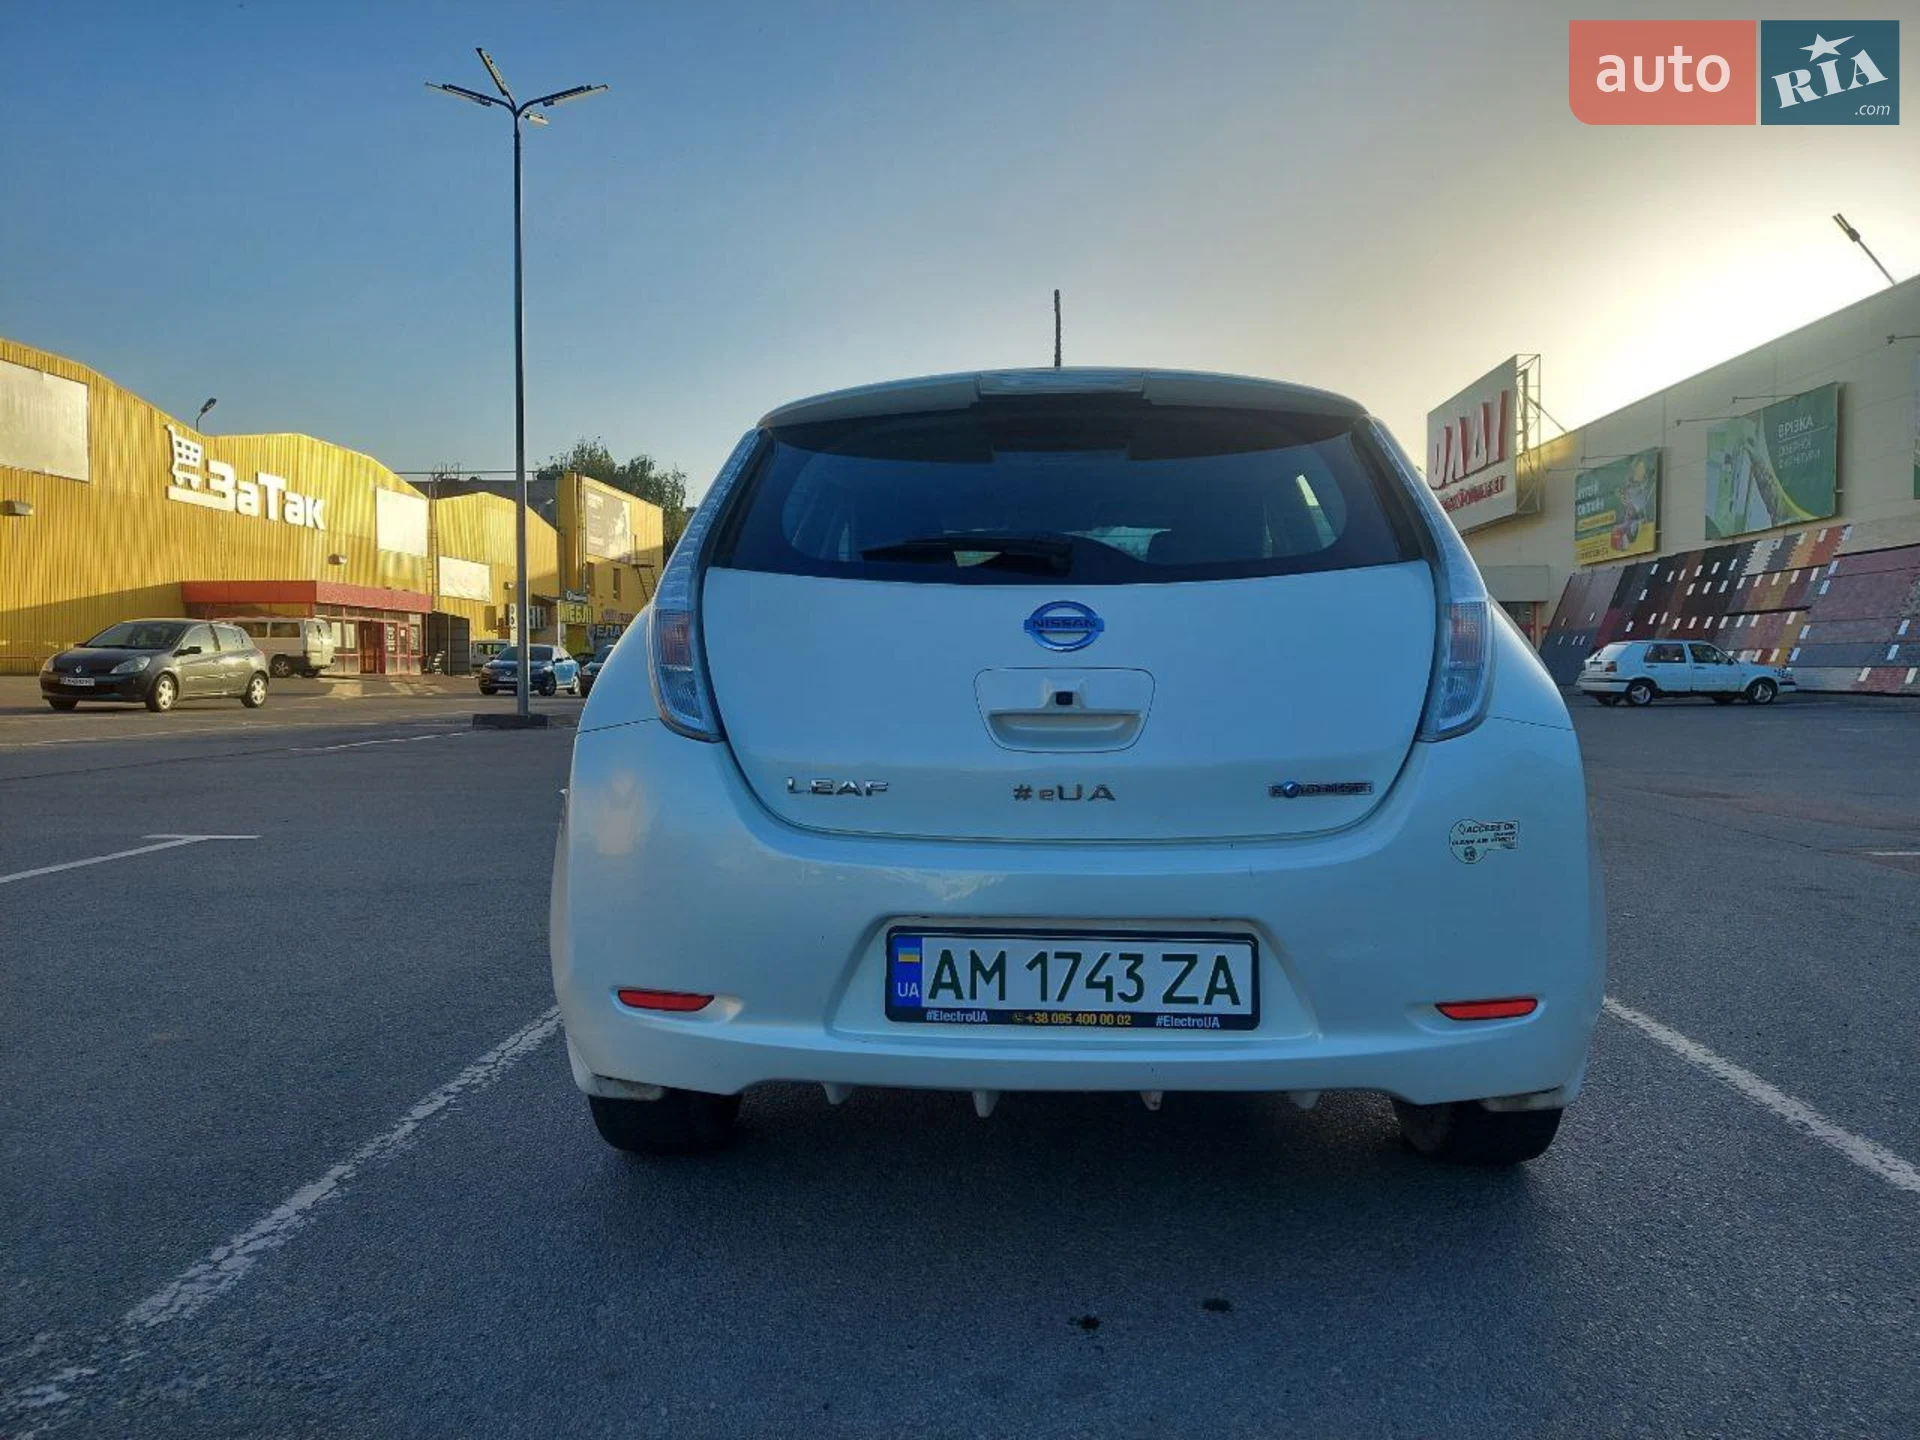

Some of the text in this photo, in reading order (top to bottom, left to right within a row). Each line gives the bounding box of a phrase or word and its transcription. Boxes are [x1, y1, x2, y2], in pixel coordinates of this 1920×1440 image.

[206, 459, 326, 531] ЗаТак
[560, 603, 593, 624] МЕБЛІ
[1032, 619, 1096, 629] NISSAN
[786, 776, 889, 797] LEAF
[1013, 783, 1116, 802] #eUA
[1466, 824, 1501, 834] ACCESS
[928, 949, 1241, 1006] AM 1743 ZA
[898, 982, 920, 998] UA
[926, 1009, 989, 1022] #ElectroUA
[1026, 1012, 1132, 1026] +38 095 400 00 02
[1156, 1015, 1220, 1028] #ElectroUA
